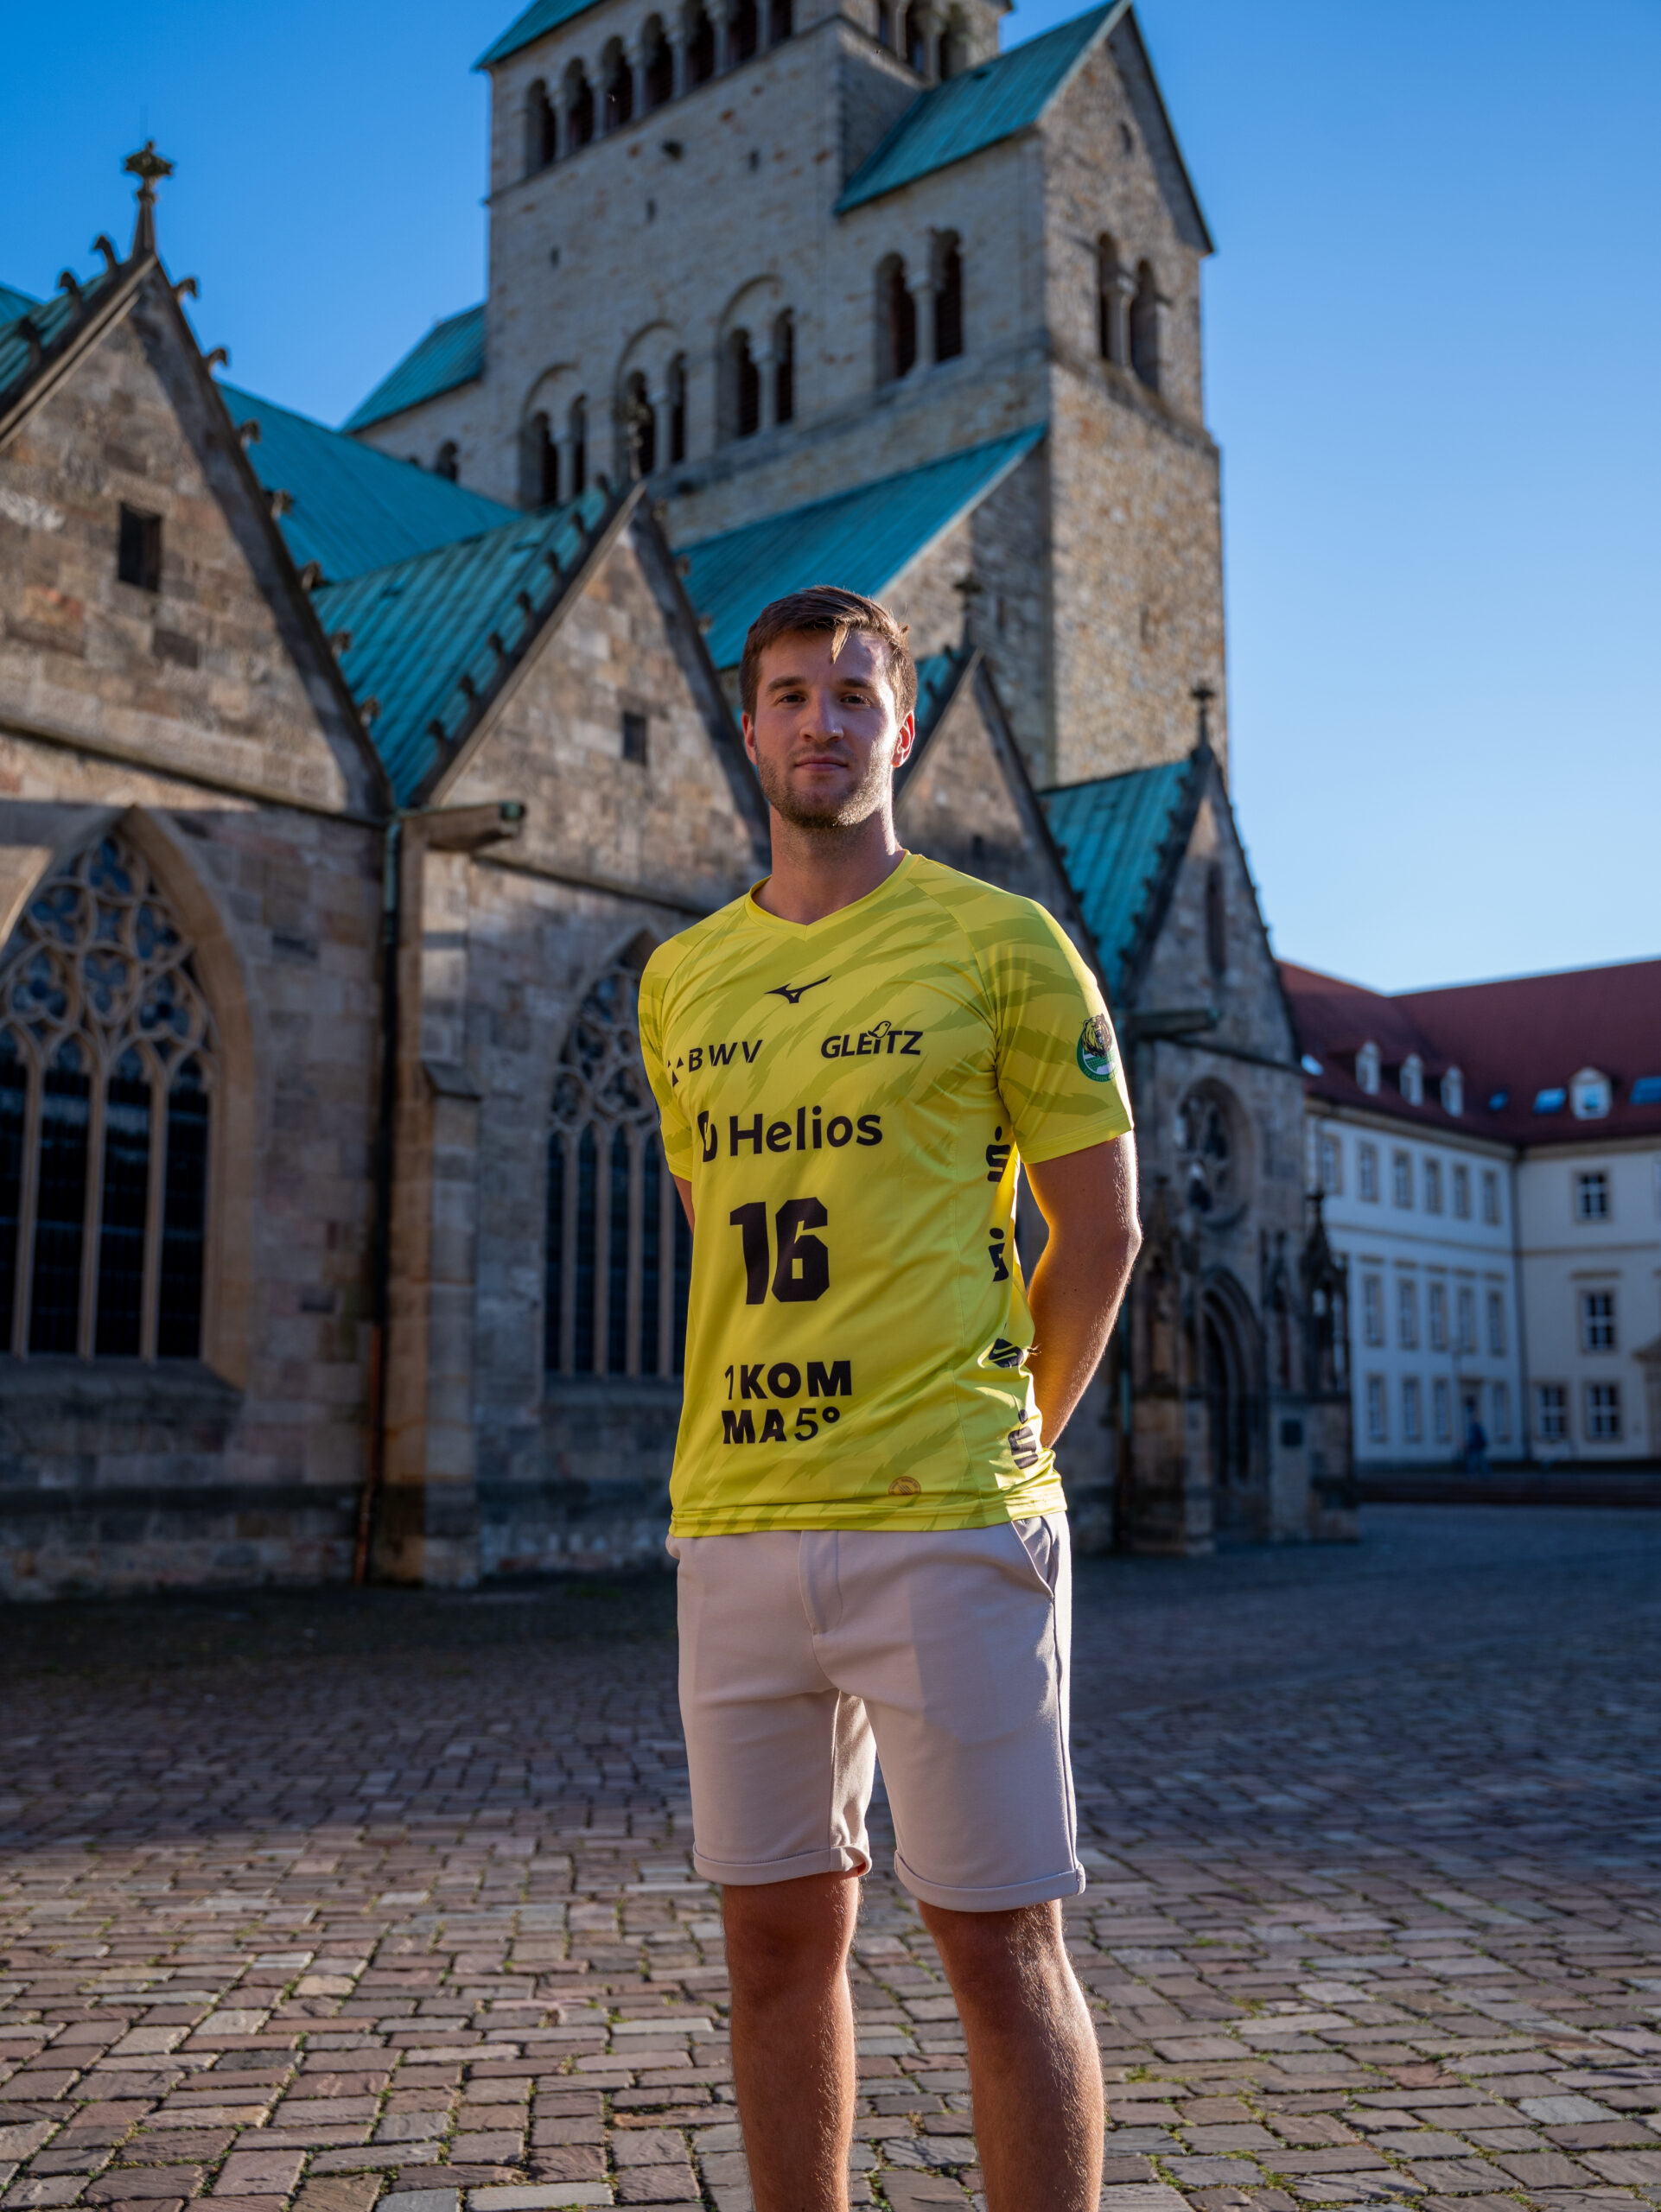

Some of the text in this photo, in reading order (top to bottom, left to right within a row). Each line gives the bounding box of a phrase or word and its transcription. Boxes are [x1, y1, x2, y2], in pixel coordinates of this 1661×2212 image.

[688, 1039, 763, 1073] BWV
[821, 1029, 924, 1059] GLEITZ
[729, 1104, 883, 1157] Helios
[729, 1196, 830, 1306] 16
[724, 1360, 852, 1401] 1KOM
